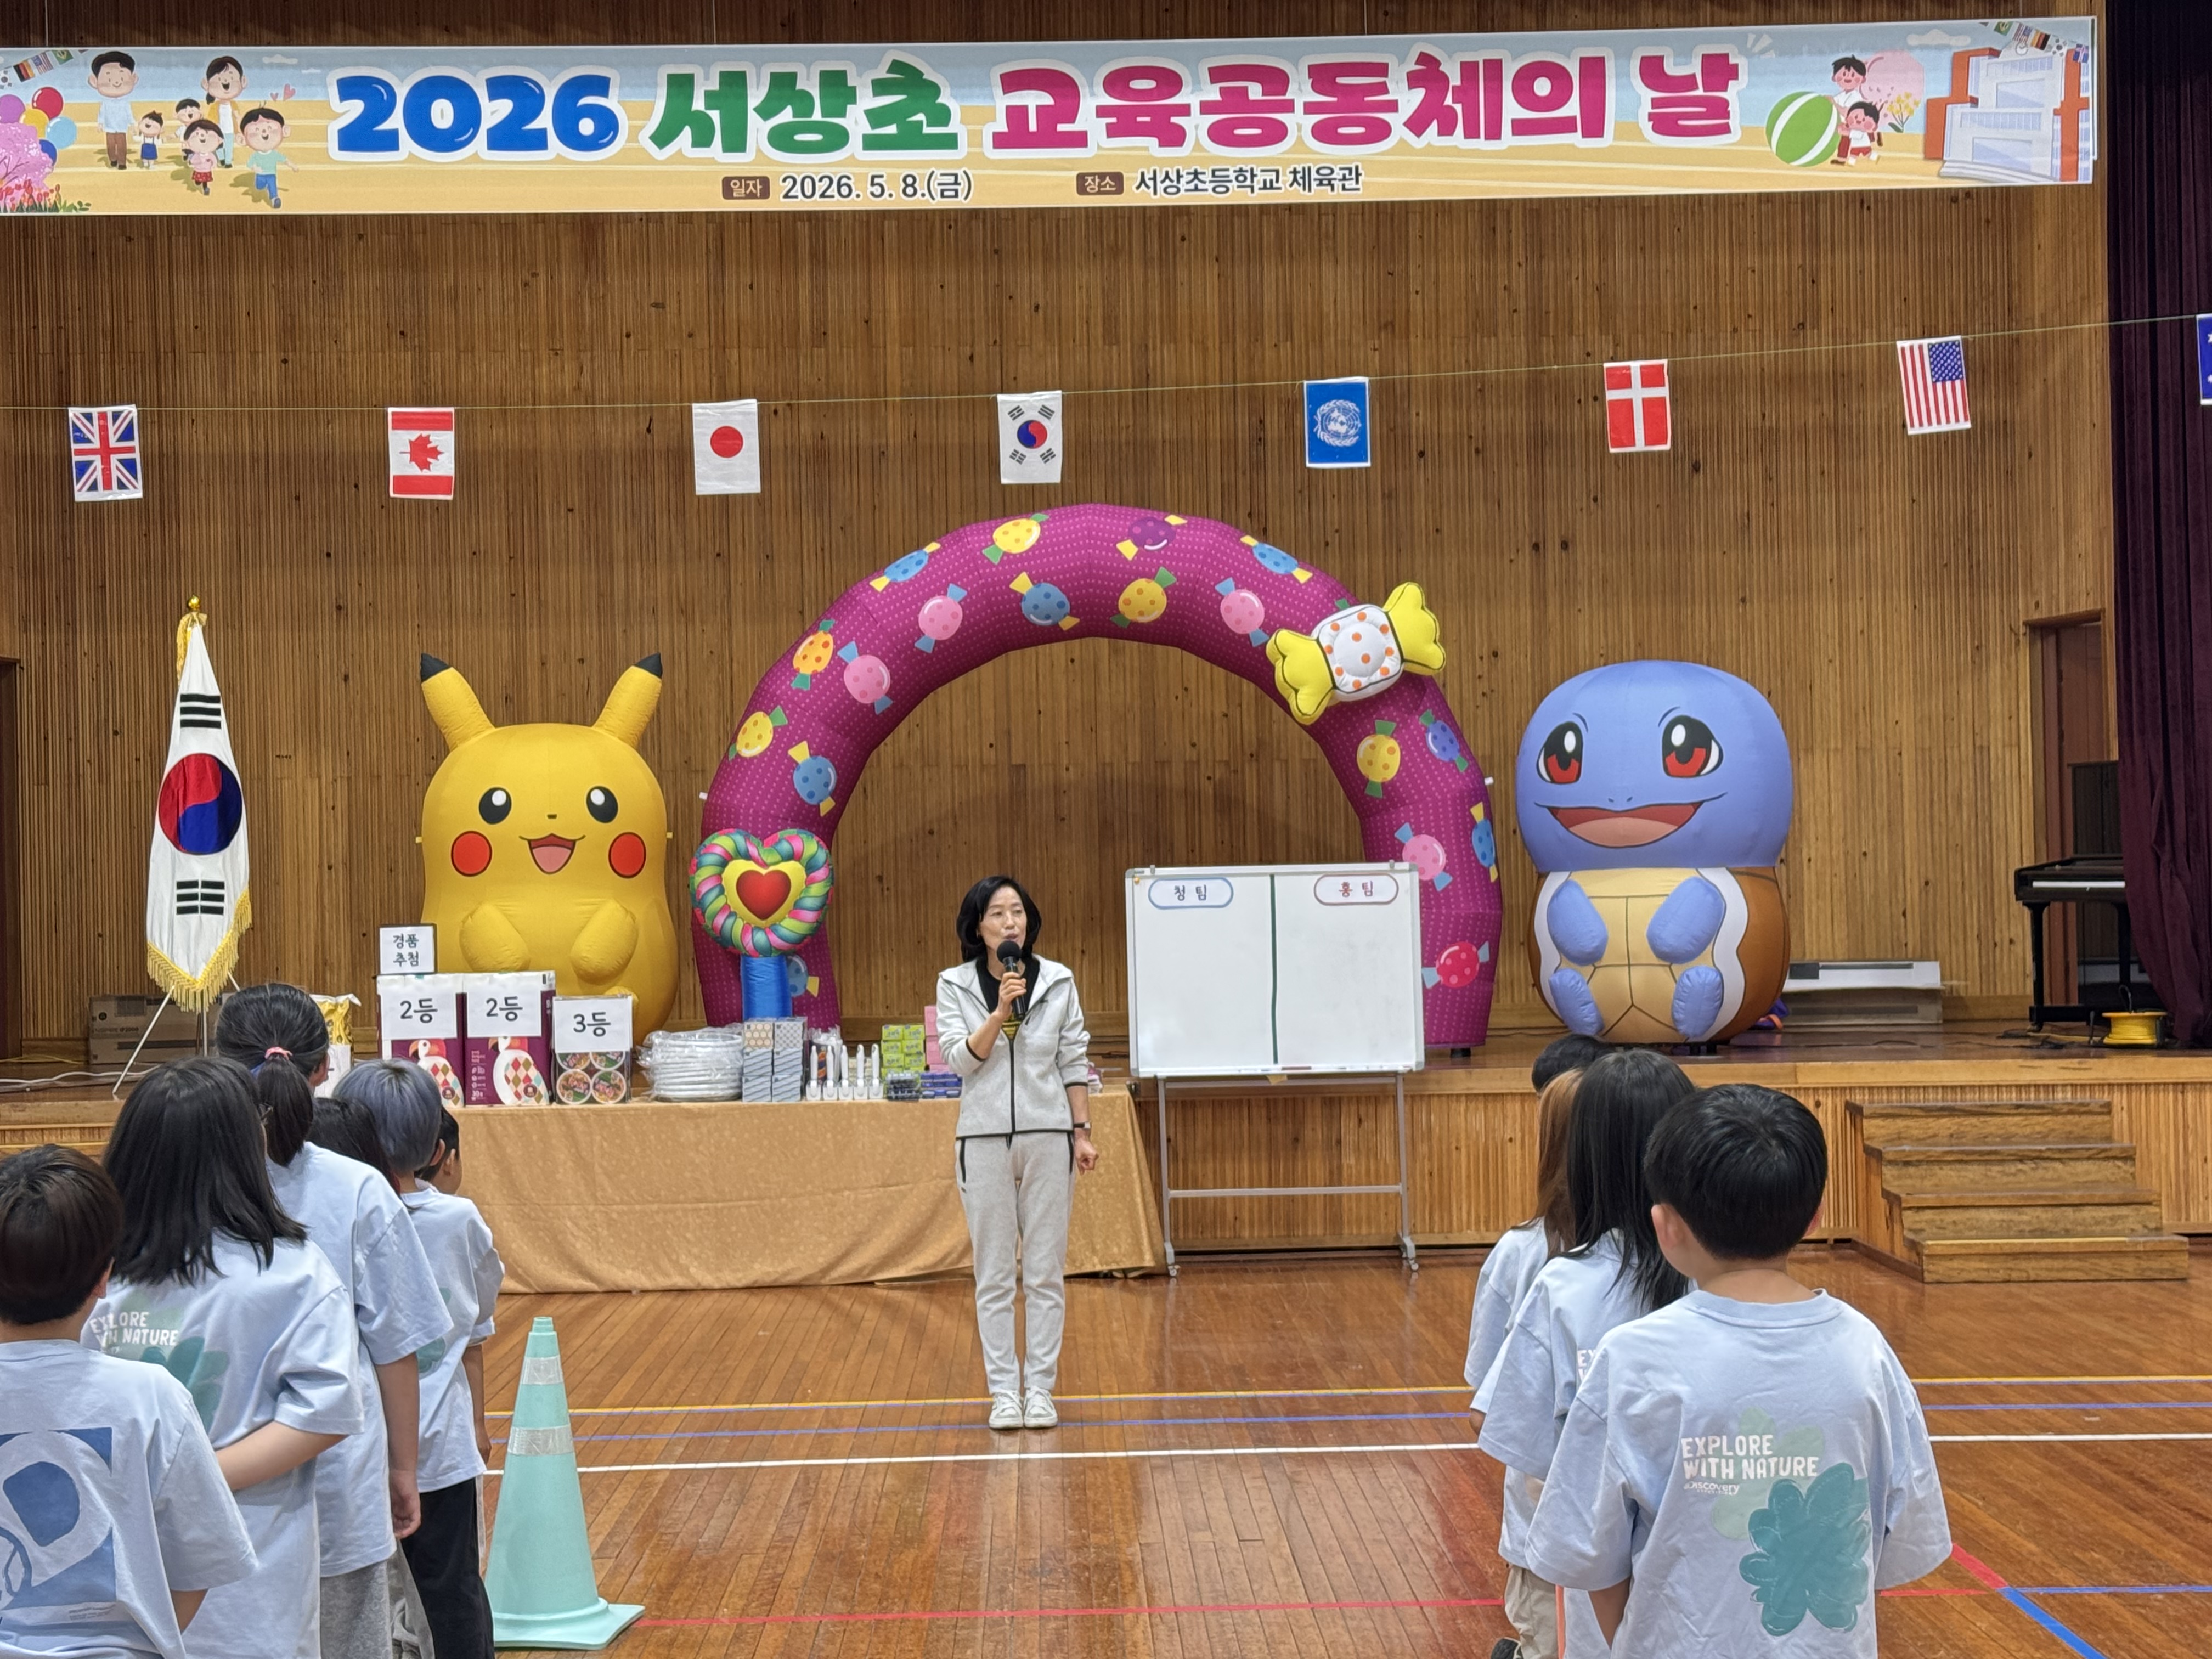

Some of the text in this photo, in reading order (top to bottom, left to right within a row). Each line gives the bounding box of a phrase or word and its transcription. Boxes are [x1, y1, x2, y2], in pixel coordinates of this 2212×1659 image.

[337, 50, 1739, 154] 2026 서상초 교육공동체의 날
[730, 180, 762, 197] 일자
[1084, 166, 1362, 195] 장소 서상초등학교 체육관
[393, 933, 419, 949] 경품
[393, 951, 419, 967] 추첨
[400, 998, 438, 1024] 2등
[486, 996, 523, 1022] 2등
[573, 1011, 611, 1037] 3등
[89, 1311, 149, 1334] EXLORE
[122, 1328, 179, 1346] NATURE
[1681, 1434, 1774, 1459] EXPLORE
[1683, 1456, 1819, 1480] WITH NATURE
